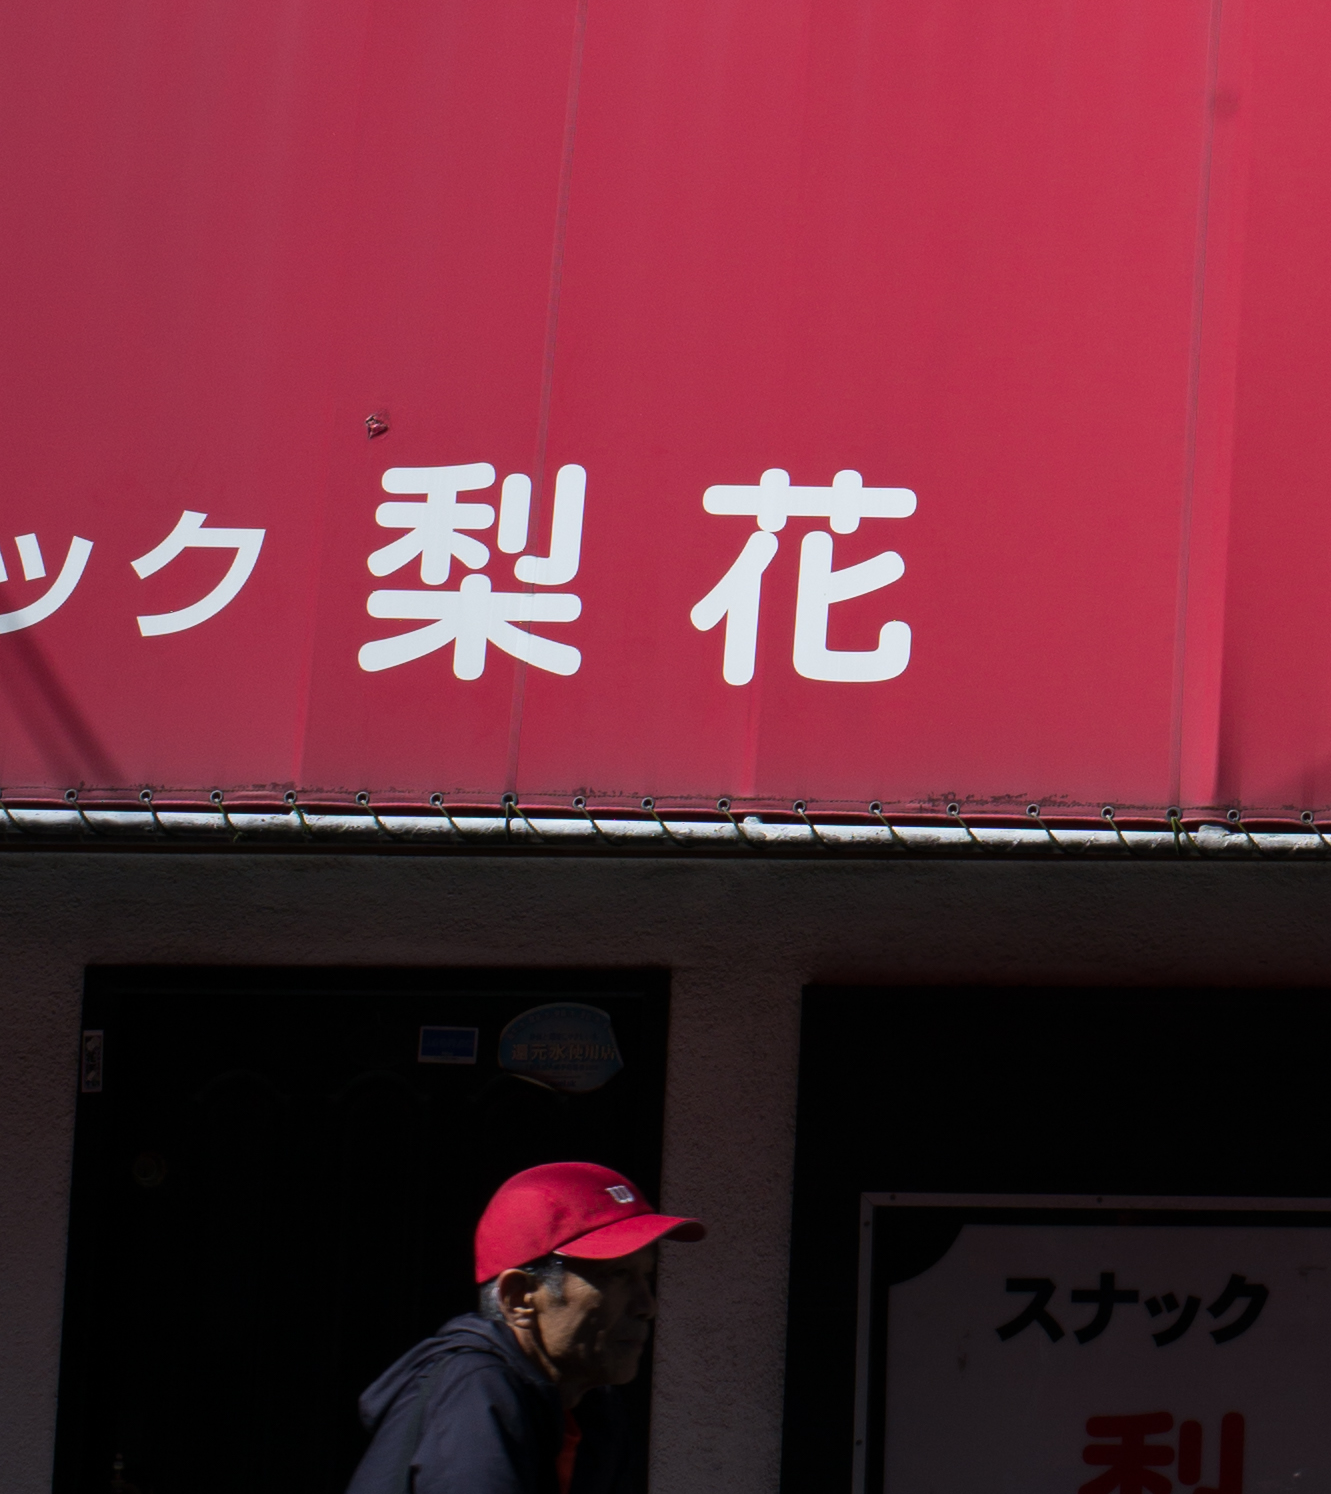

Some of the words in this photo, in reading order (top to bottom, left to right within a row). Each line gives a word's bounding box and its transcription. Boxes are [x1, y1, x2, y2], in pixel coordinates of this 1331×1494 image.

[357, 461, 918, 686] 梨花
[995, 1272, 1269, 1347] スナック
